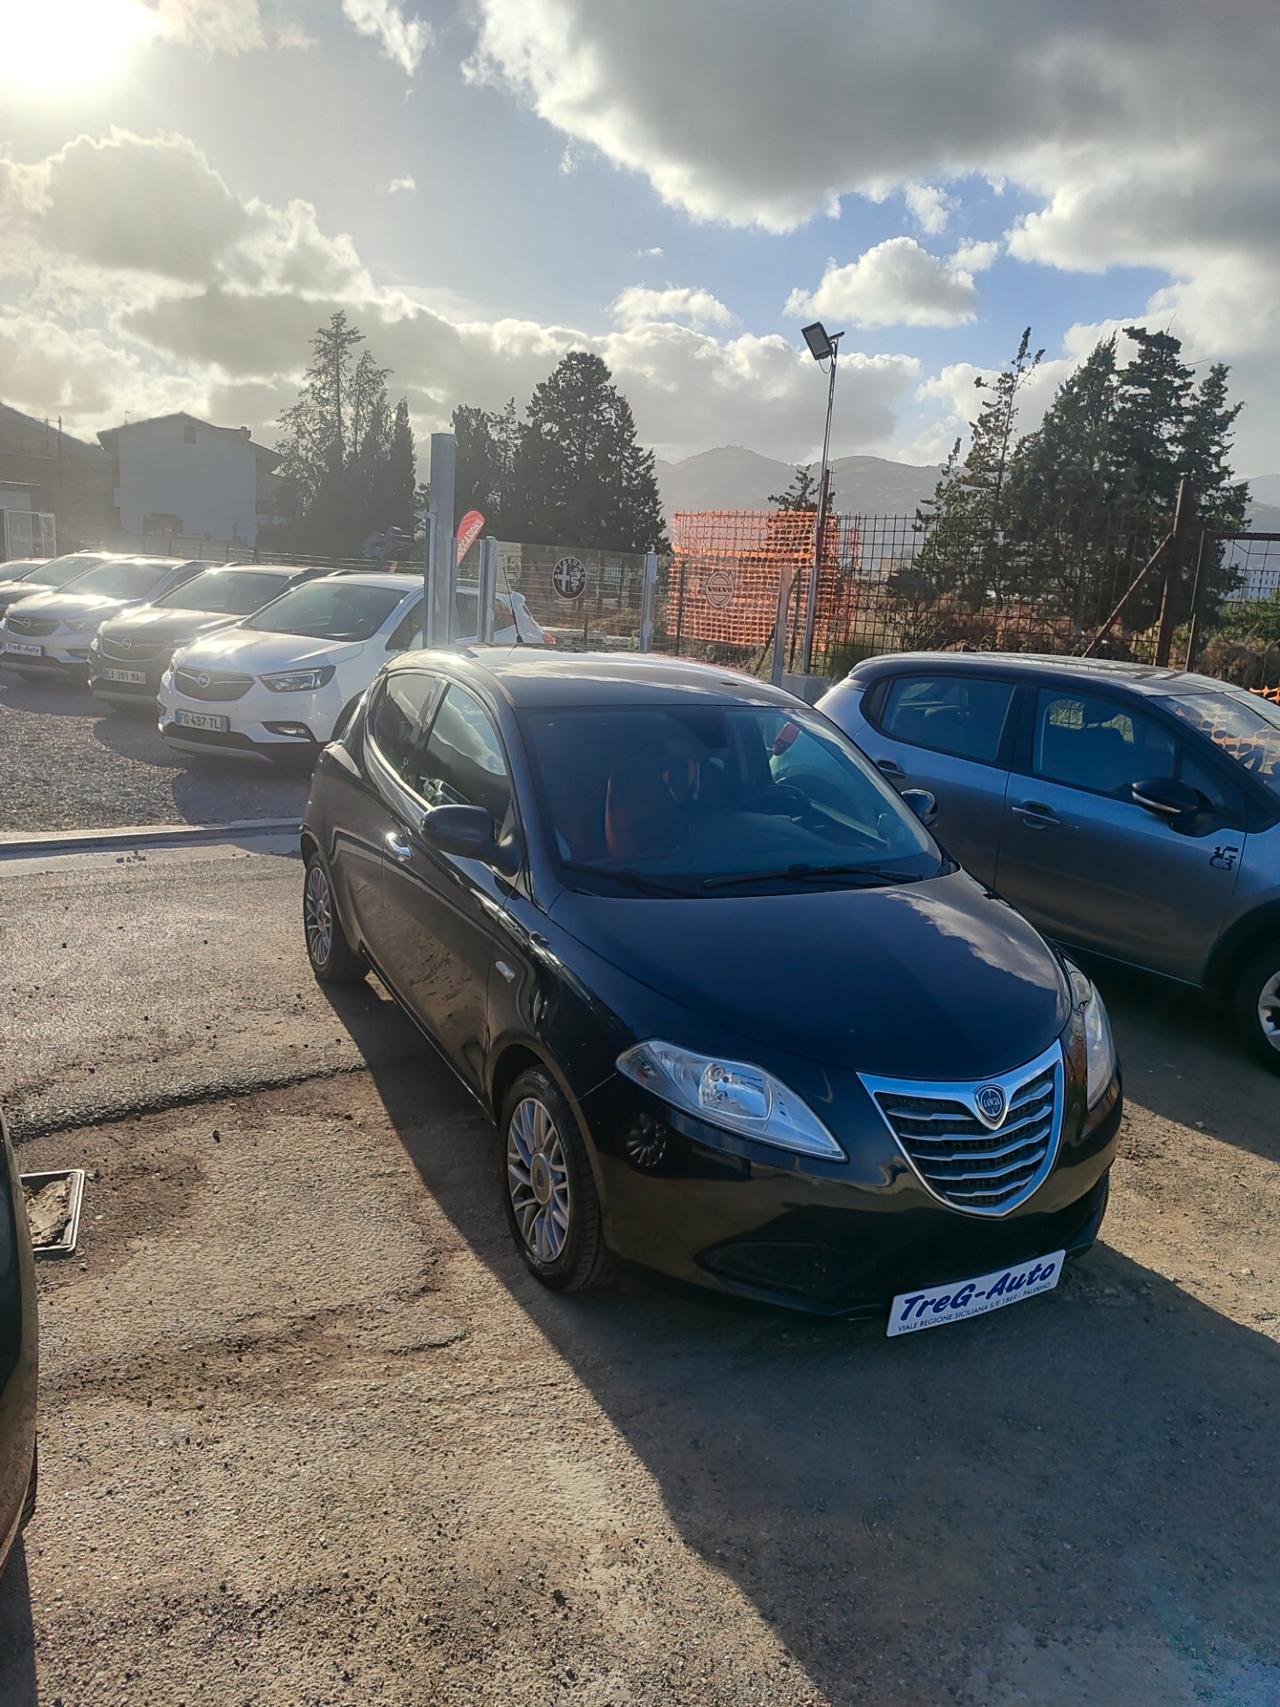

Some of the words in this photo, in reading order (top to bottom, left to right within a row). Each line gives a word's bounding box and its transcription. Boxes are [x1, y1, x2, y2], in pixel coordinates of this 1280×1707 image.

[898, 1321, 919, 1332] VIALE
[919, 1314, 953, 1327] REGIONE
[955, 1305, 988, 1319] SICILIANA
[1022, 1282, 1051, 1296] PALERMO
[900, 1262, 1056, 1321] TreG-Auto
